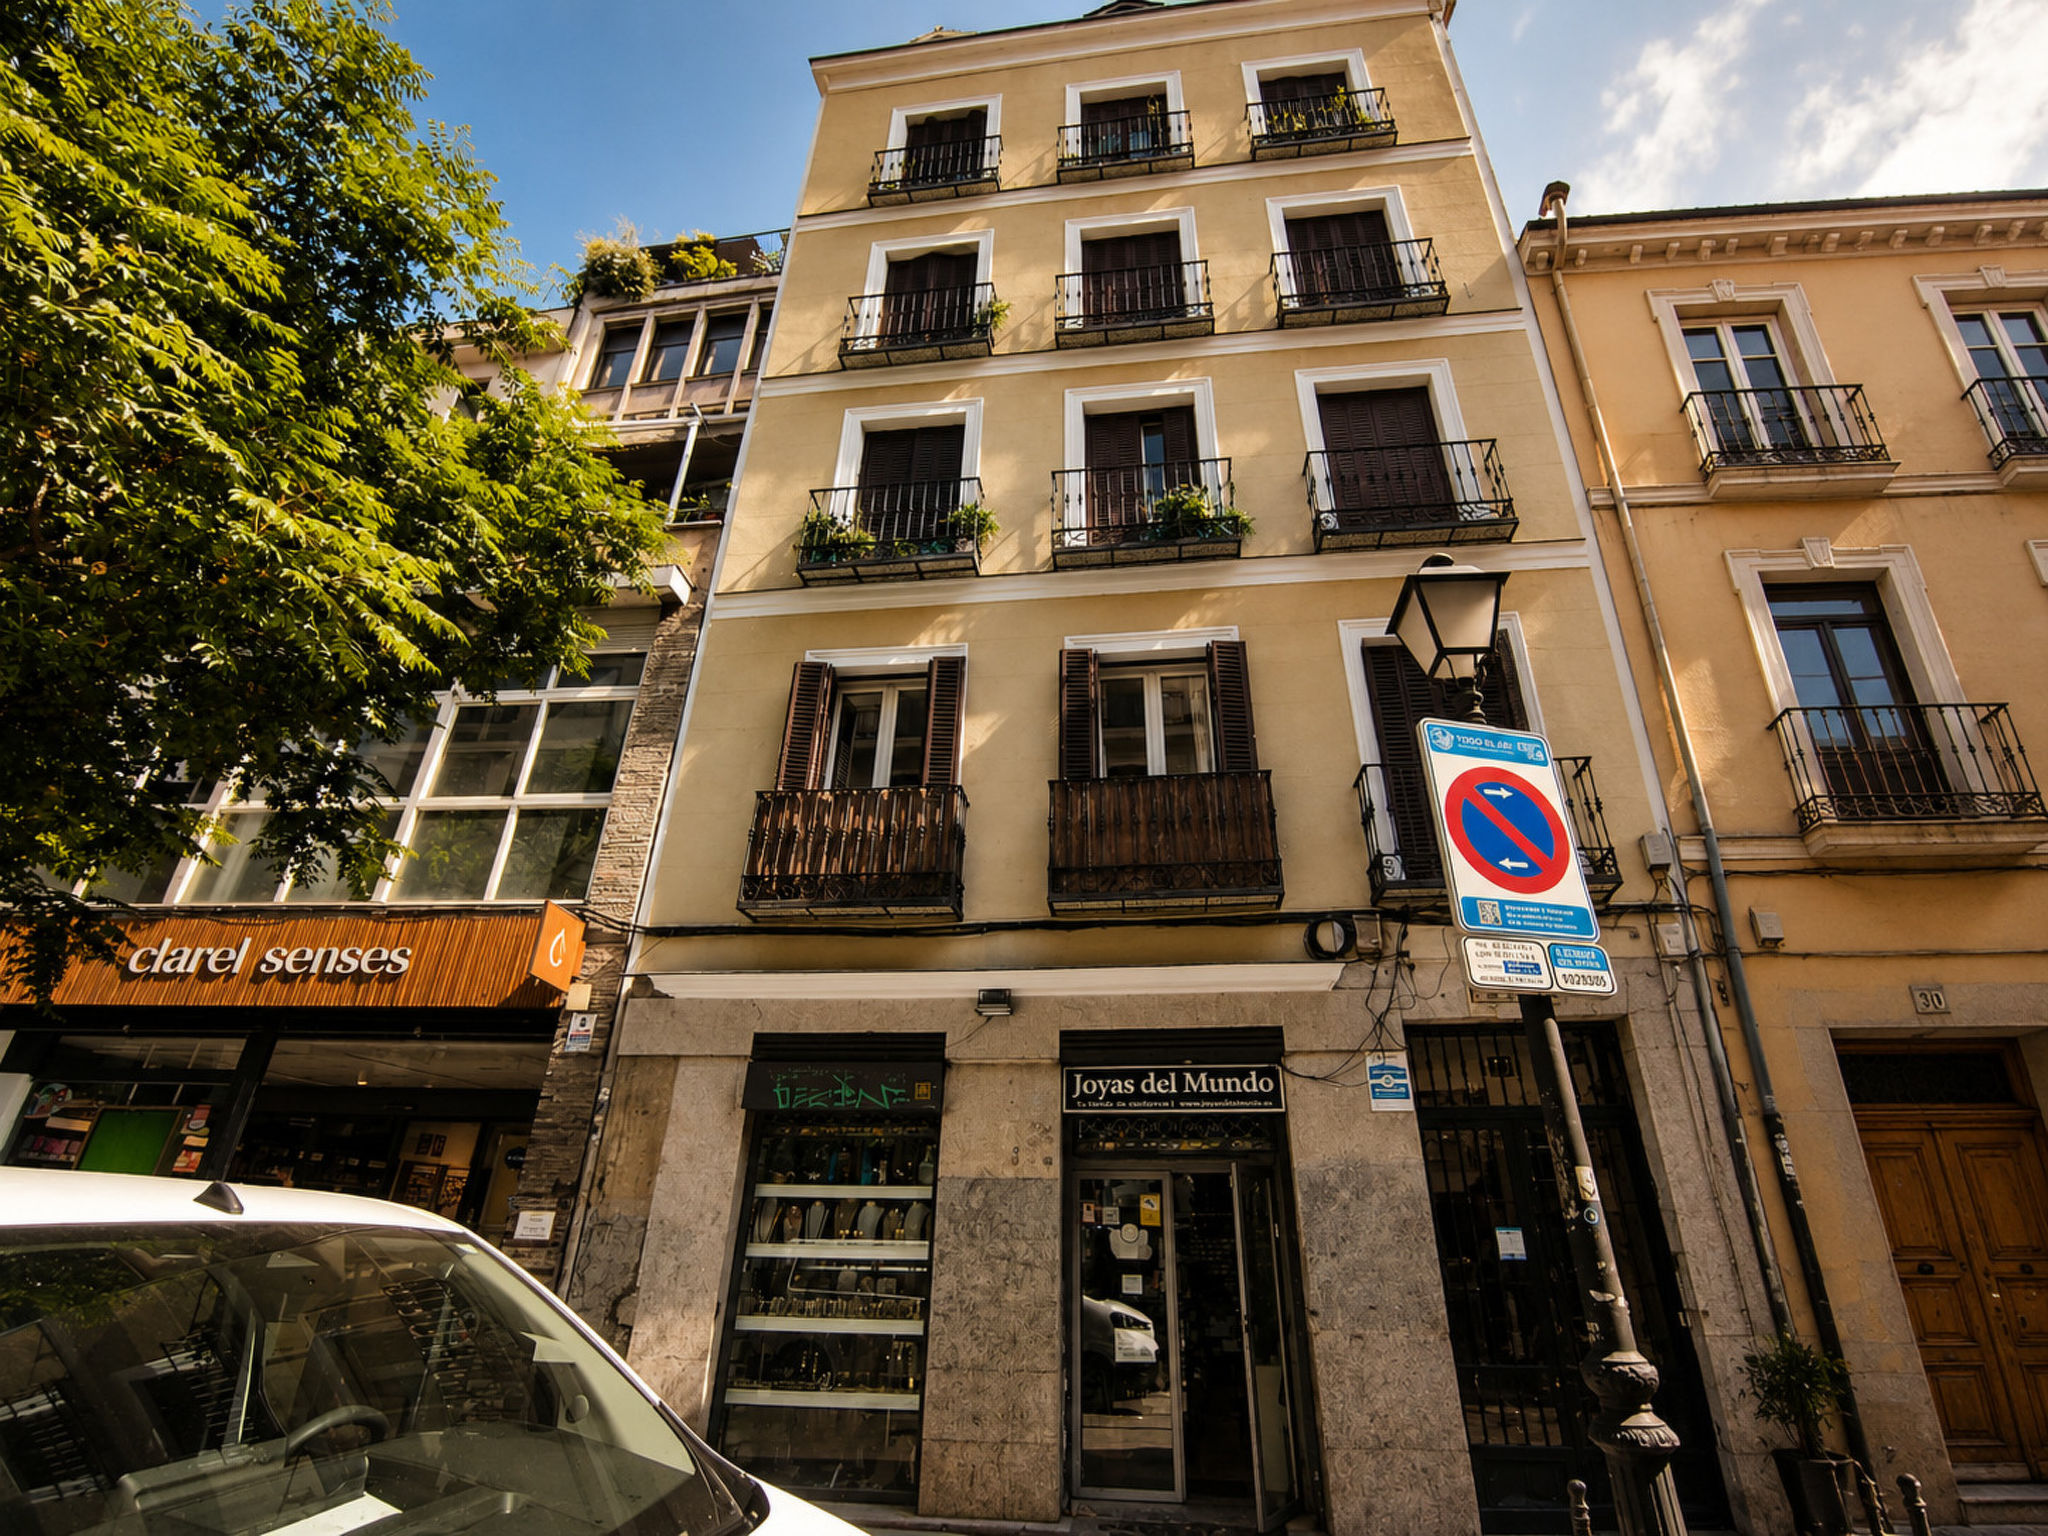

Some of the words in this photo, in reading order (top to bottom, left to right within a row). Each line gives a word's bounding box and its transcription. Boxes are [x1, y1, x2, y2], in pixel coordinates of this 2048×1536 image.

[128, 936, 252, 975] clarel
[260, 946, 412, 975] senses
[1918, 991, 1945, 1010] 30
[1071, 1073, 1135, 1100] Joyas
[1141, 1071, 1177, 1094] del
[1182, 1071, 1274, 1094] Mundo
